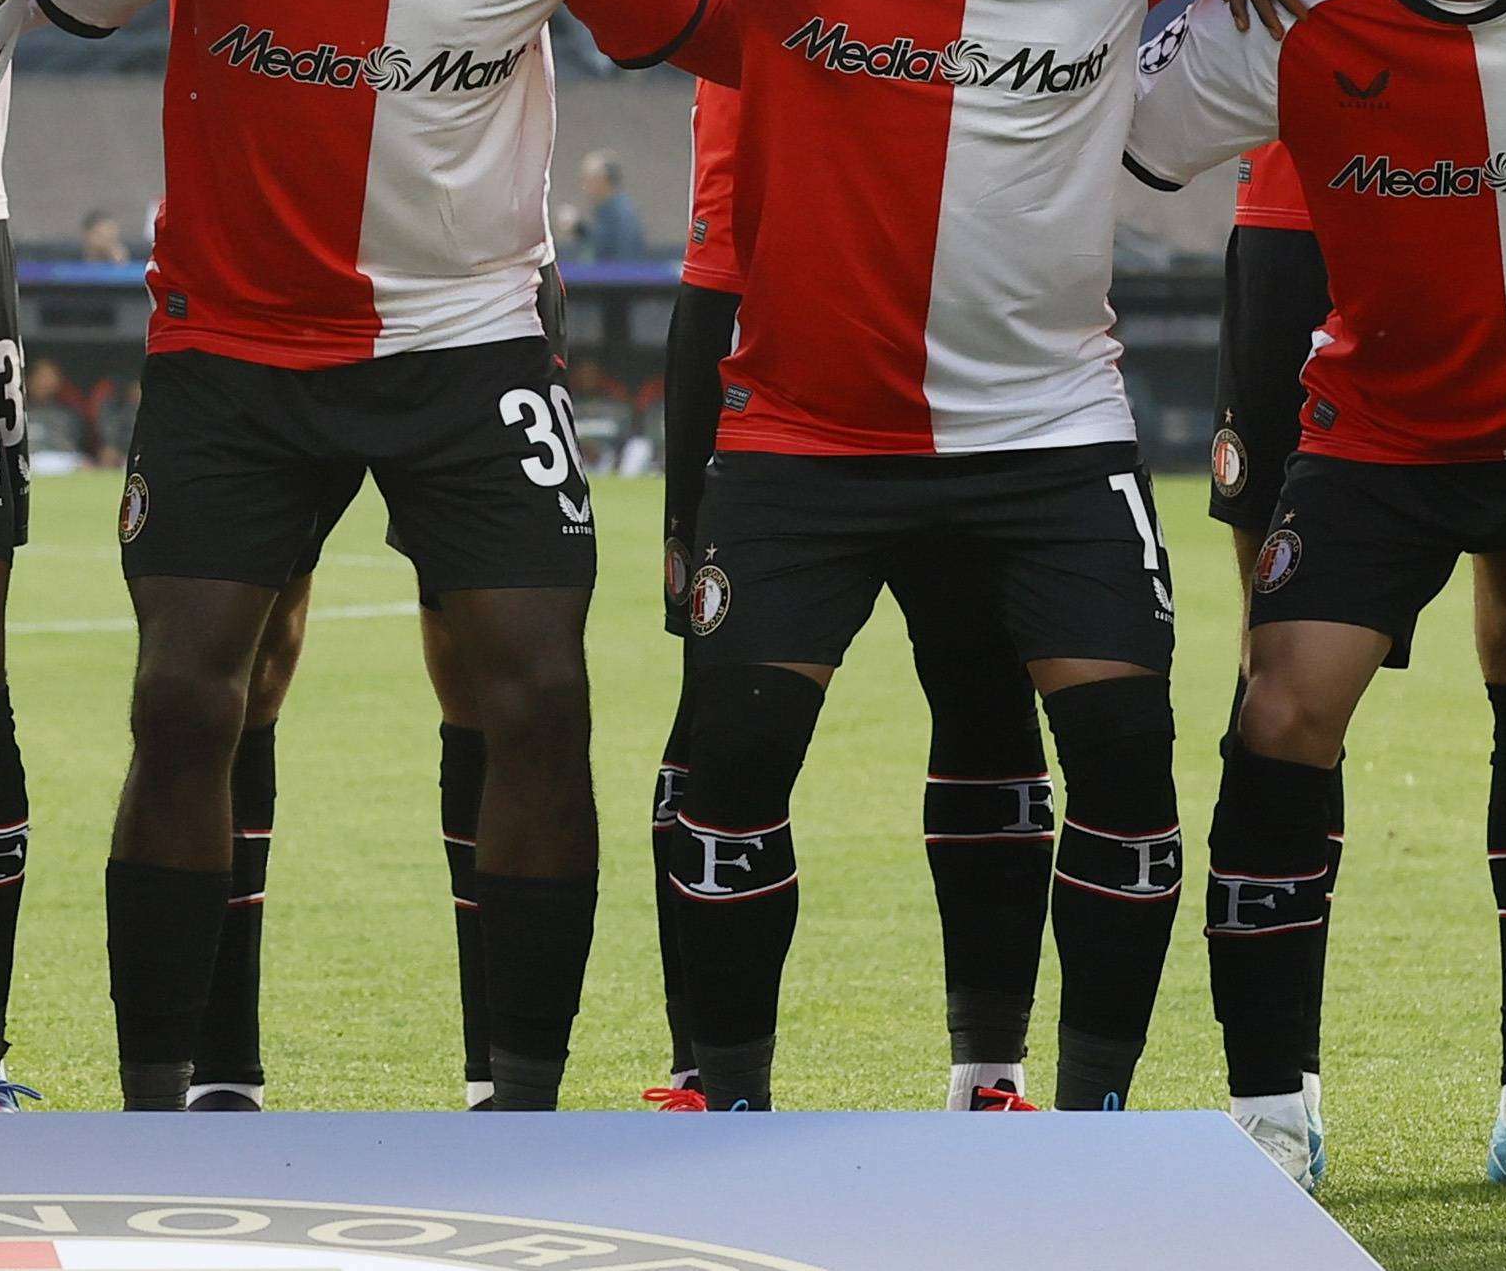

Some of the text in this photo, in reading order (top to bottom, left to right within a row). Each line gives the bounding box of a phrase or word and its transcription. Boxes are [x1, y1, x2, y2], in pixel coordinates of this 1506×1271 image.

[209, 24, 526, 92] Media Markt
[782, 16, 1108, 94] Media Markt
[1328, 155, 1481, 197] Media
[1108, 472, 1166, 570] 1
[690, 832, 764, 894] F
[1121, 834, 1181, 892] F
[1215, 879, 1295, 928] F
